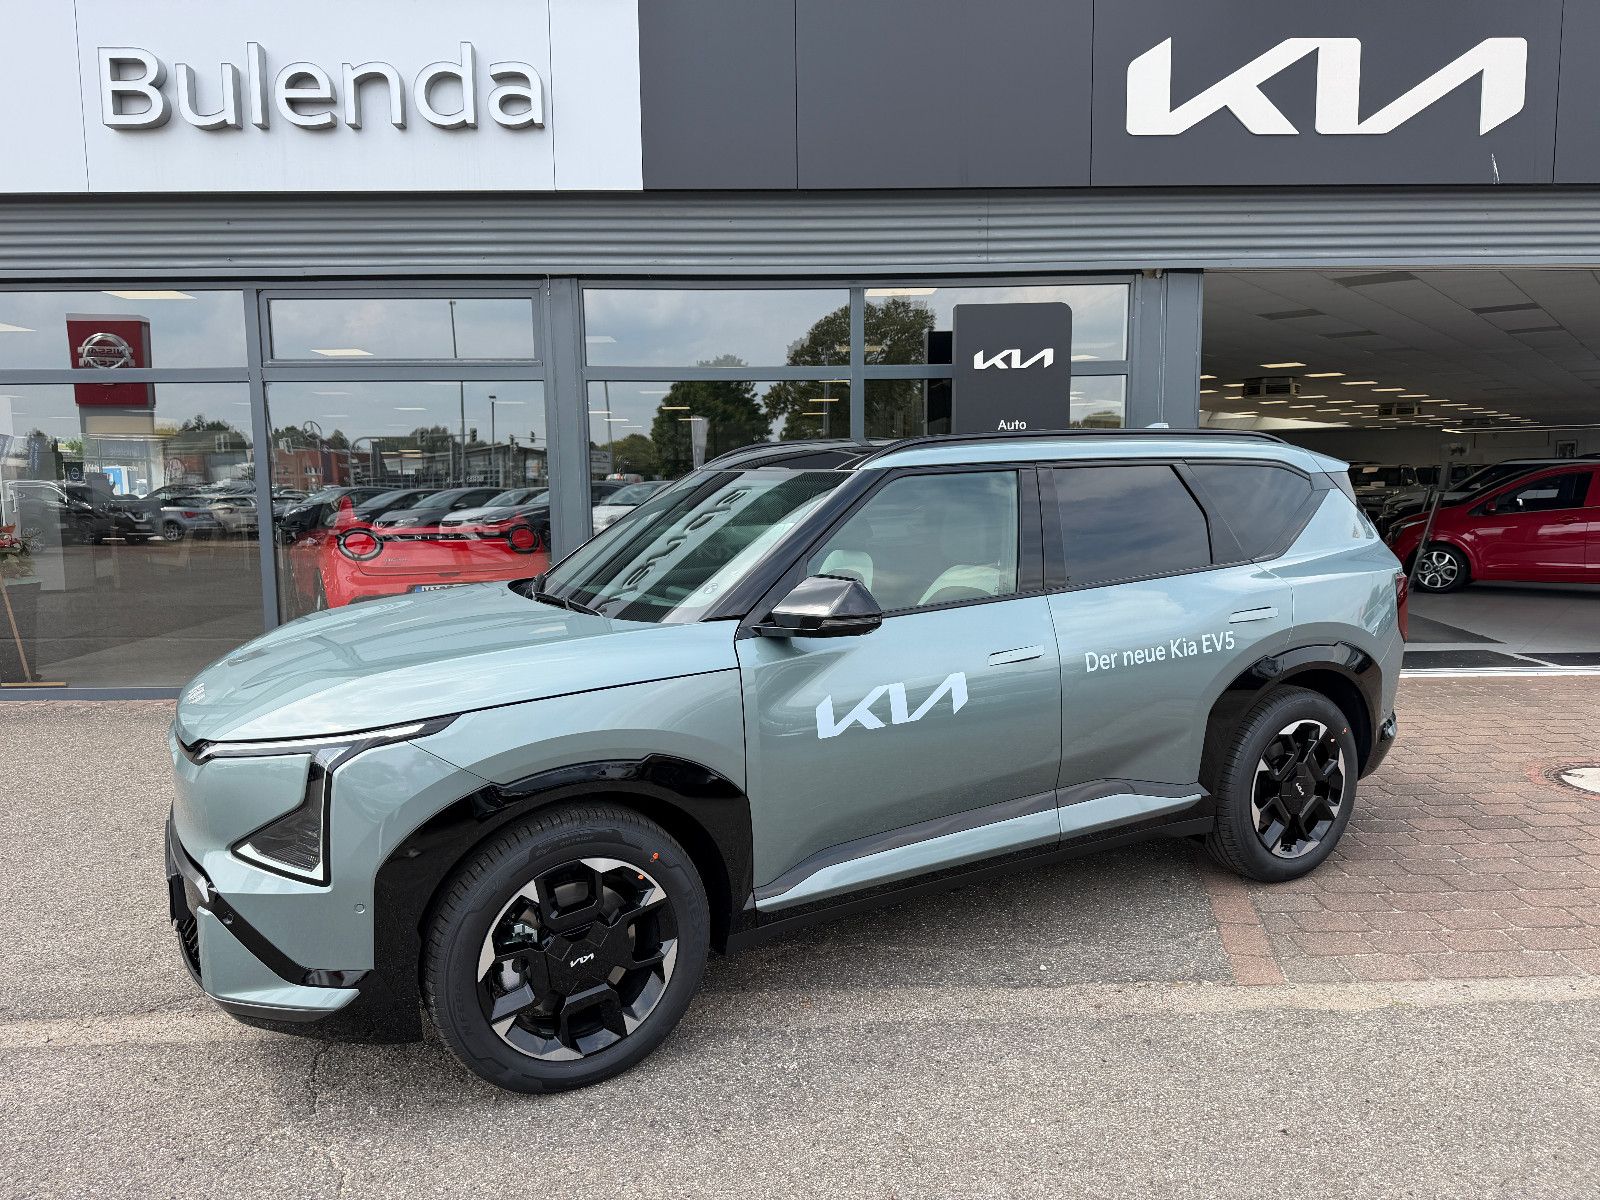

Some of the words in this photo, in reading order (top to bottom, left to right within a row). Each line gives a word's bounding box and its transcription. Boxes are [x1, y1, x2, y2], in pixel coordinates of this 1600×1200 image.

[97, 41, 545, 131] Bulenda
[1126, 37, 1528, 136] KIA
[973, 348, 1054, 370] KIA
[997, 419, 1027, 431] Auto
[1084, 651, 1118, 673] Der
[1123, 645, 1166, 667] neue
[1169, 637, 1198, 659] Kia
[1201, 630, 1235, 654] EV5
[815, 671, 969, 740] KIA
